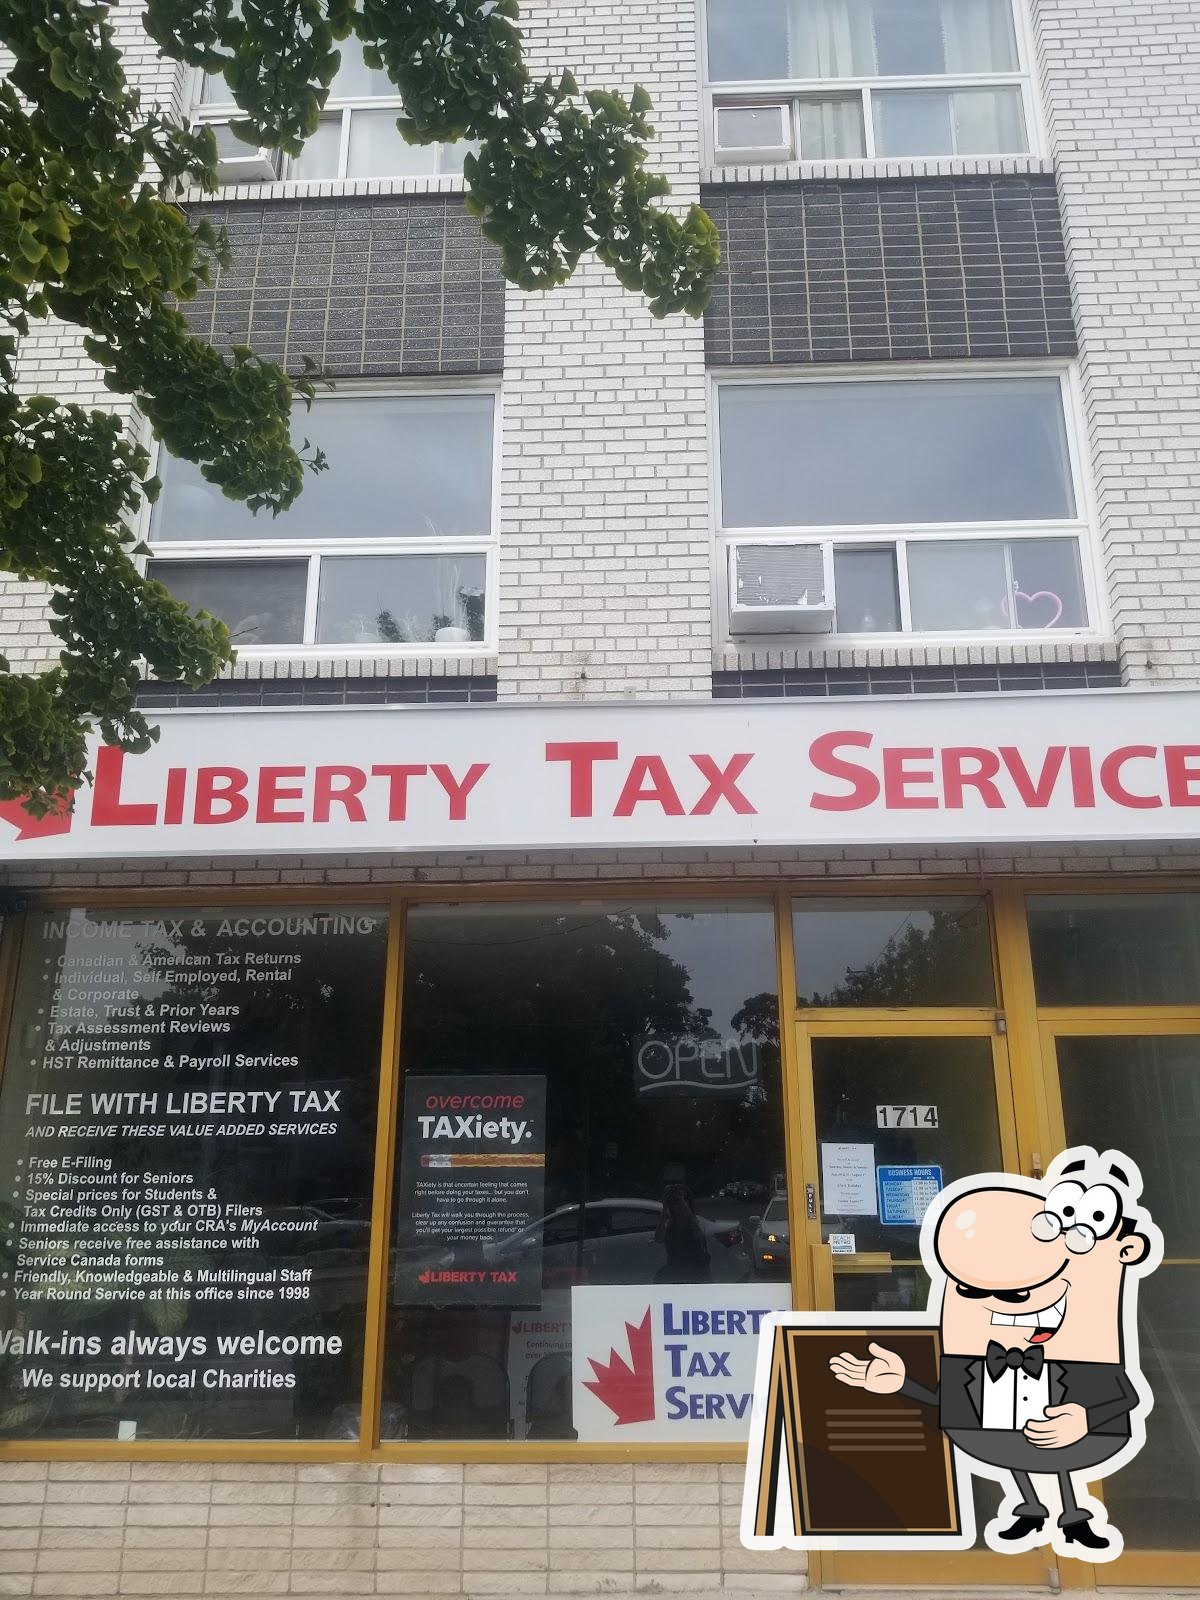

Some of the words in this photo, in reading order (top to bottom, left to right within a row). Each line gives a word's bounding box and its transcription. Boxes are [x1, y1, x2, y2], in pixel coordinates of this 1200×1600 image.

[90, 744, 491, 827] LIBERTY
[545, 742, 760, 818] TAX
[808, 730, 1200, 812] SERVICE
[43, 920, 133, 939] INCOME
[141, 919, 184, 938] TAX
[190, 919, 207, 938] &
[216, 916, 377, 936] ACCOUNTING
[57, 955, 123, 967] Canadian
[128, 954, 139, 966] &
[142, 953, 211, 966] American
[216, 953, 241, 965] Tax
[244, 952, 302, 965] Returns
[54, 971, 128, 985] Individual,
[133, 970, 162, 983] Self
[165, 969, 241, 985] Employed,
[245, 968, 292, 982] Rental
[52, 988, 63, 1001] &
[68, 988, 139, 1003] Corporate
[50, 1005, 98, 1019] Estate,
[104, 1004, 141, 1017] Trust
[144, 1004, 156, 1017] &
[160, 1004, 196, 1017] Prior
[200, 1003, 240, 1016] Years
[48, 1022, 72, 1034] Tax
[75, 1021, 166, 1034] Assessment
[170, 1020, 231, 1033] Reviews
[45, 1039, 56, 1052] &
[59, 1039, 151, 1055] Adjustments
[42, 1056, 74, 1069] HST
[77, 1056, 160, 1069] Remittance
[163, 1055, 175, 1068] &
[179, 1054, 231, 1071] Payroll
[234, 1054, 299, 1067] Services
[637, 1038, 759, 1080] OPEN
[25, 1093, 83, 1115] FILE
[91, 1092, 158, 1115] WITH
[166, 1090, 282, 1114] LIBERTY
[289, 1090, 341, 1112] TAX
[426, 1094, 525, 1110] overcome
[878, 1106, 938, 1127] 1714
[25, 1126, 55, 1138] AND
[57, 1125, 118, 1138] RECEIVE
[121, 1124, 166, 1137] THESE
[169, 1124, 215, 1137] VALUE
[216, 1123, 265, 1136] ADDED
[268, 1123, 338, 1136] SERVICES
[28, 1157, 58, 1169] Free
[61, 1155, 112, 1171] E-Filing
[27, 1173, 54, 1185] 15%
[58, 1173, 118, 1185] Discount
[120, 1172, 140, 1184] for
[143, 1172, 194, 1184] Seniors
[914, 1168, 932, 1176] HOURS
[25, 1189, 74, 1203] Special
[77, 1189, 118, 1203] prices
[122, 1189, 141, 1201] for
[144, 1188, 203, 1200] Students
[207, 1187, 218, 1200] &
[24, 1205, 47, 1218] Tax
[50, 1205, 97, 1218] Credits
[101, 1205, 133, 1219] Only
[136, 1204, 170, 1219] (GST
[173, 1204, 184, 1217] &
[187, 1204, 222, 1219] OTB)
[225, 1204, 263, 1217] Filers
[20, 1220, 90, 1233] Immediate
[93, 1222, 140, 1233] access
[144, 1220, 157, 1232] to
[160, 1221, 192, 1235] your
[195, 1219, 237, 1232] CRA's
[241, 1219, 319, 1234] MyAccount
[19, 1237, 70, 1250] Seniors
[73, 1237, 122, 1250] receive
[126, 1237, 152, 1249] free
[155, 1236, 228, 1249] assistance
[231, 1236, 260, 1249] with
[16, 1254, 67, 1266] Service
[70, 1254, 121, 1266] Canada
[125, 1254, 164, 1266] forms
[14, 1270, 71, 1285] Friendly,
[75, 1269, 179, 1285] Knowledgeable
[182, 1269, 193, 1282] &
[197, 1269, 276, 1285] Multilingual
[280, 1268, 313, 1282] Staff
[430, 1271, 486, 1283] LIBERTY
[490, 1271, 517, 1283] TAX
[13, 1287, 44, 1300] Year
[46, 1287, 92, 1300] Round
[95, 1287, 146, 1300] Service
[149, 1288, 163, 1300] at
[166, 1287, 192, 1300] this
[195, 1286, 234, 1300] office
[237, 1287, 274, 1300] since
[278, 1286, 311, 1300] 1998
[662, 1302, 786, 1336] LIBERT
[110, 1330, 207, 1362] always
[217, 1329, 343, 1355] welcome
[663, 1344, 732, 1378] TAX
[22, 1368, 54, 1388] We
[59, 1369, 142, 1393] support
[146, 1368, 197, 1388] local
[202, 1368, 297, 1388] Charities
